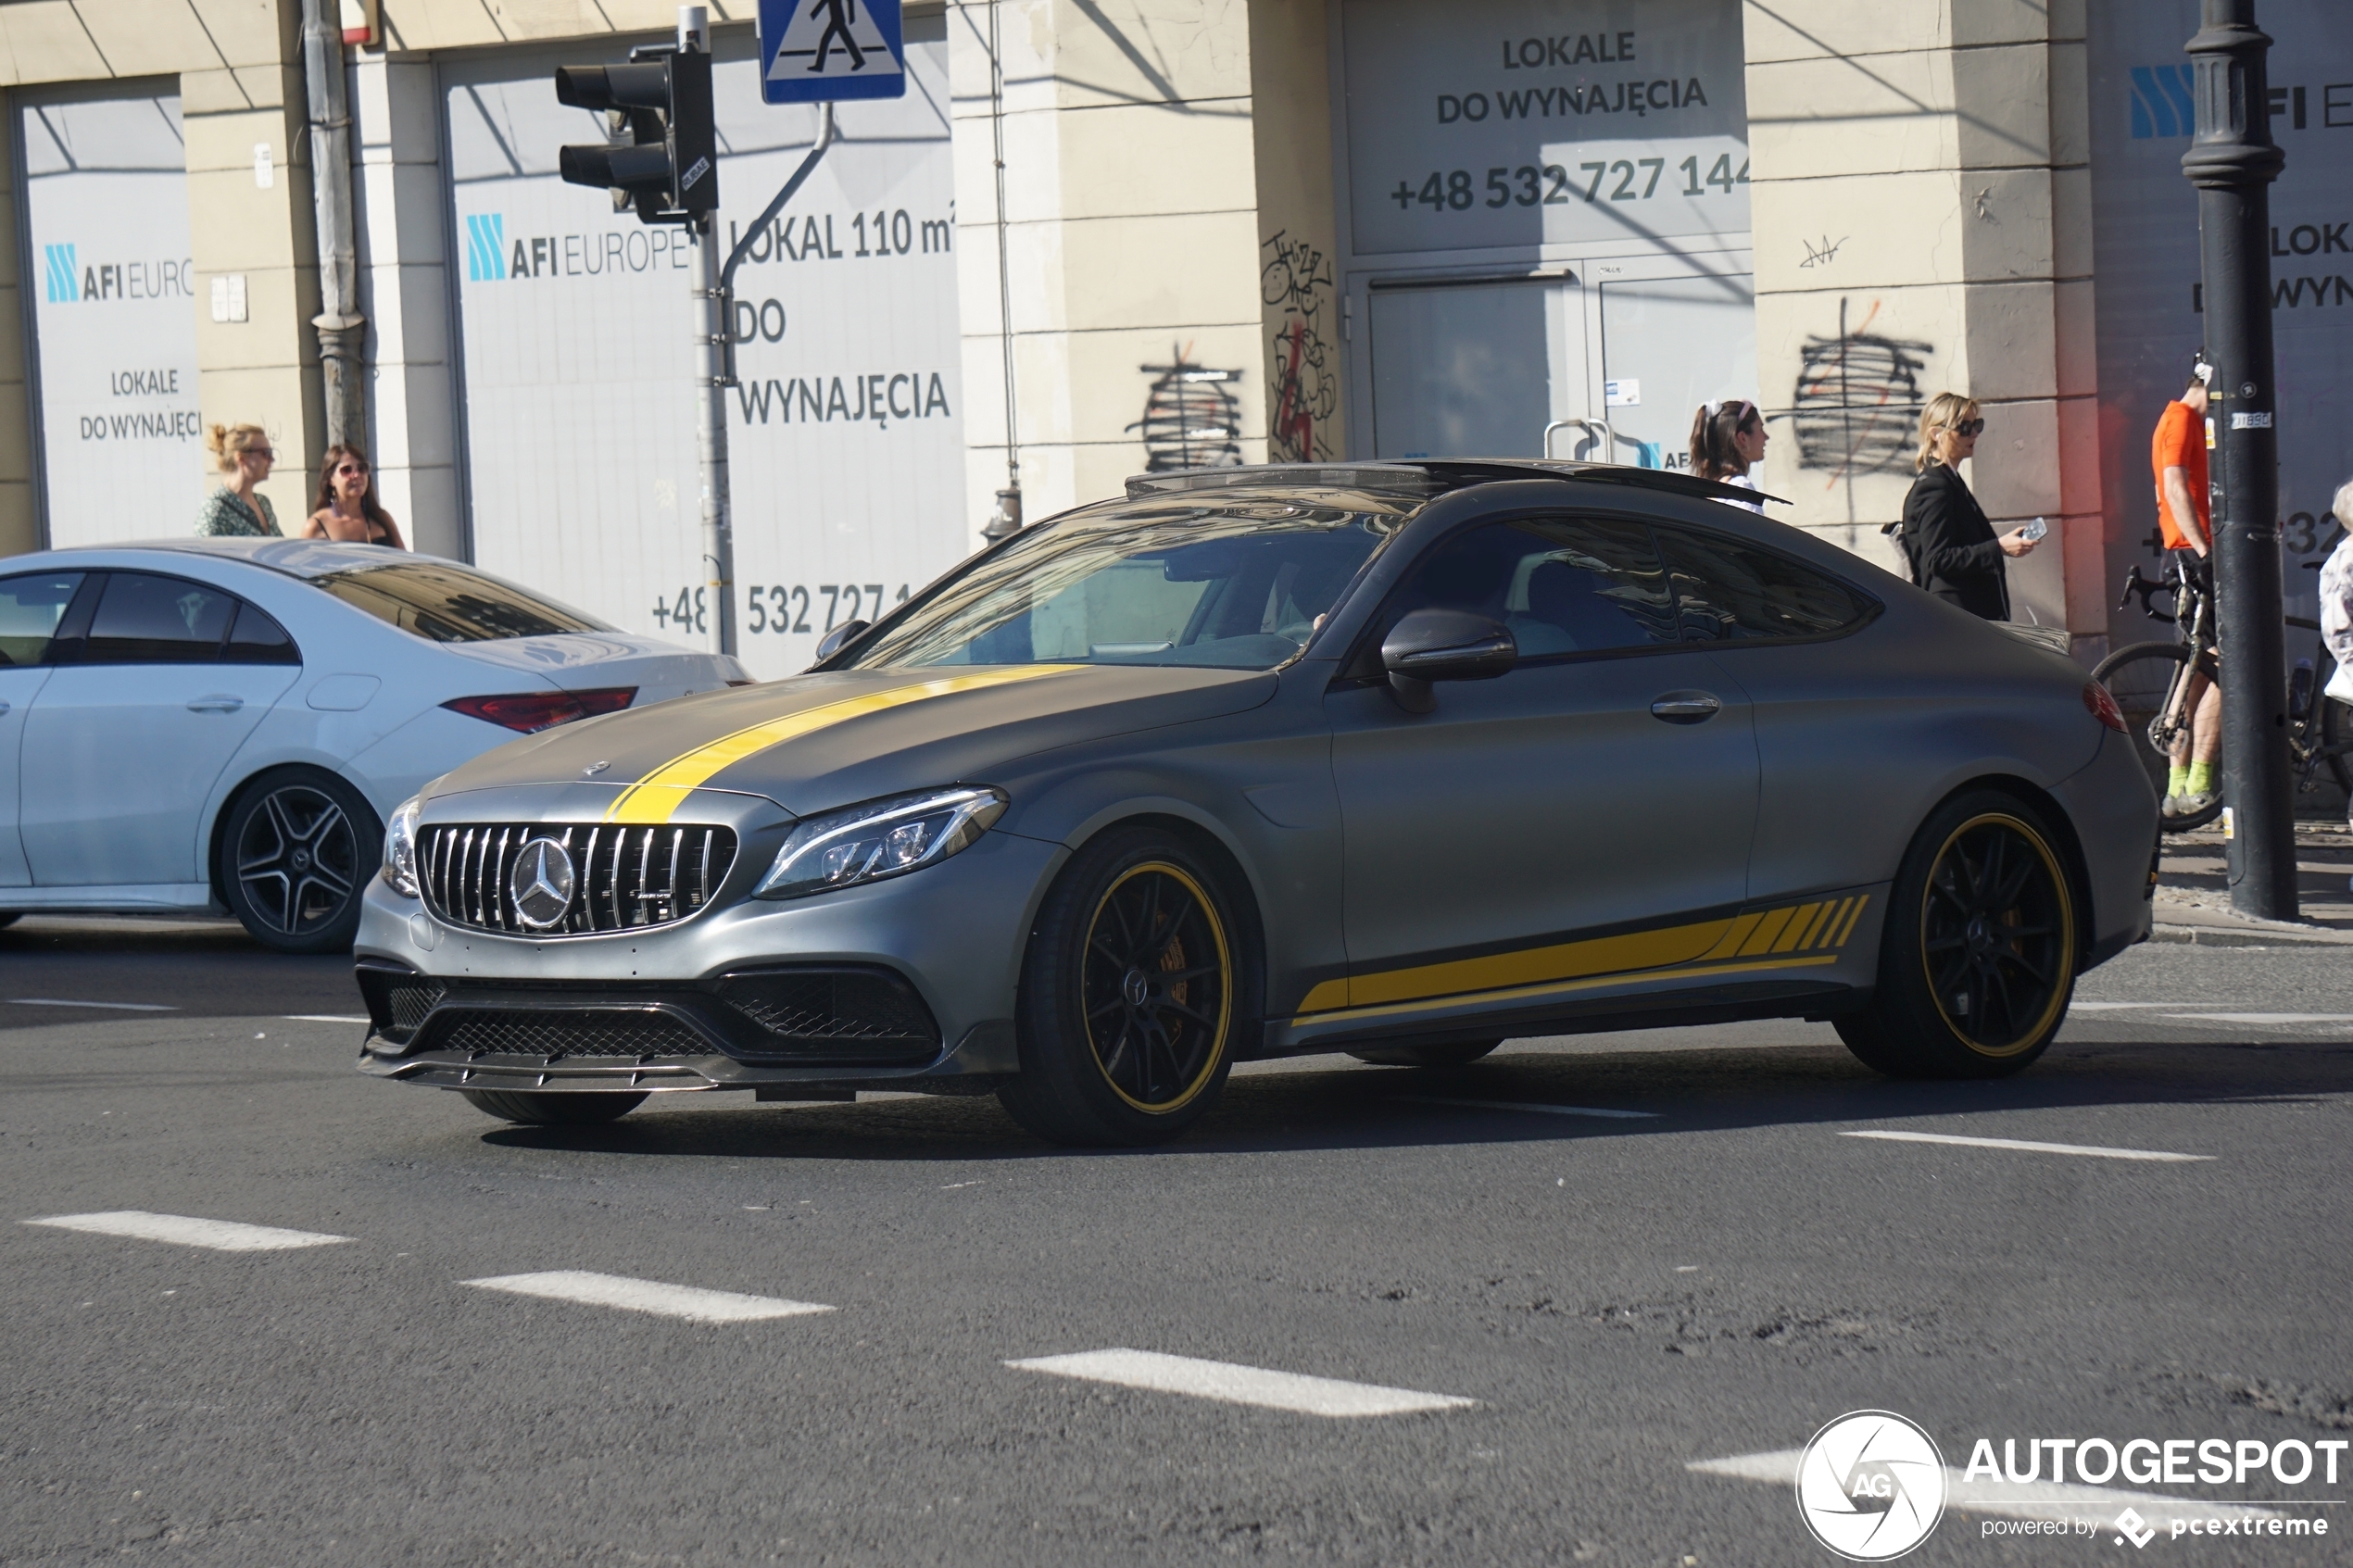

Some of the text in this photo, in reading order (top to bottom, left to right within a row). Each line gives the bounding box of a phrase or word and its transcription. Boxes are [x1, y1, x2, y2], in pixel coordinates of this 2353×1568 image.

[1503, 31, 1636, 69] LOKALE
[1437, 77, 1708, 124] DO WYNAJĘCIA
[1390, 169, 1474, 212] +48
[1485, 163, 1569, 208] 532
[1580, 157, 1665, 203] 727
[511, 228, 689, 279] AFI EUROPE
[730, 215, 843, 265] LOKAL
[852, 208, 912, 257] 110
[2271, 221, 2353, 257] LOK
[83, 265, 123, 302] AFI
[735, 298, 786, 345] DO
[112, 370, 179, 396] LOKALE
[738, 372, 951, 431] WYNAJĘCIA
[81, 416, 107, 441] DO
[1665, 452, 1689, 470] AF
[749, 584, 812, 633] 532
[820, 584, 884, 633] 727
